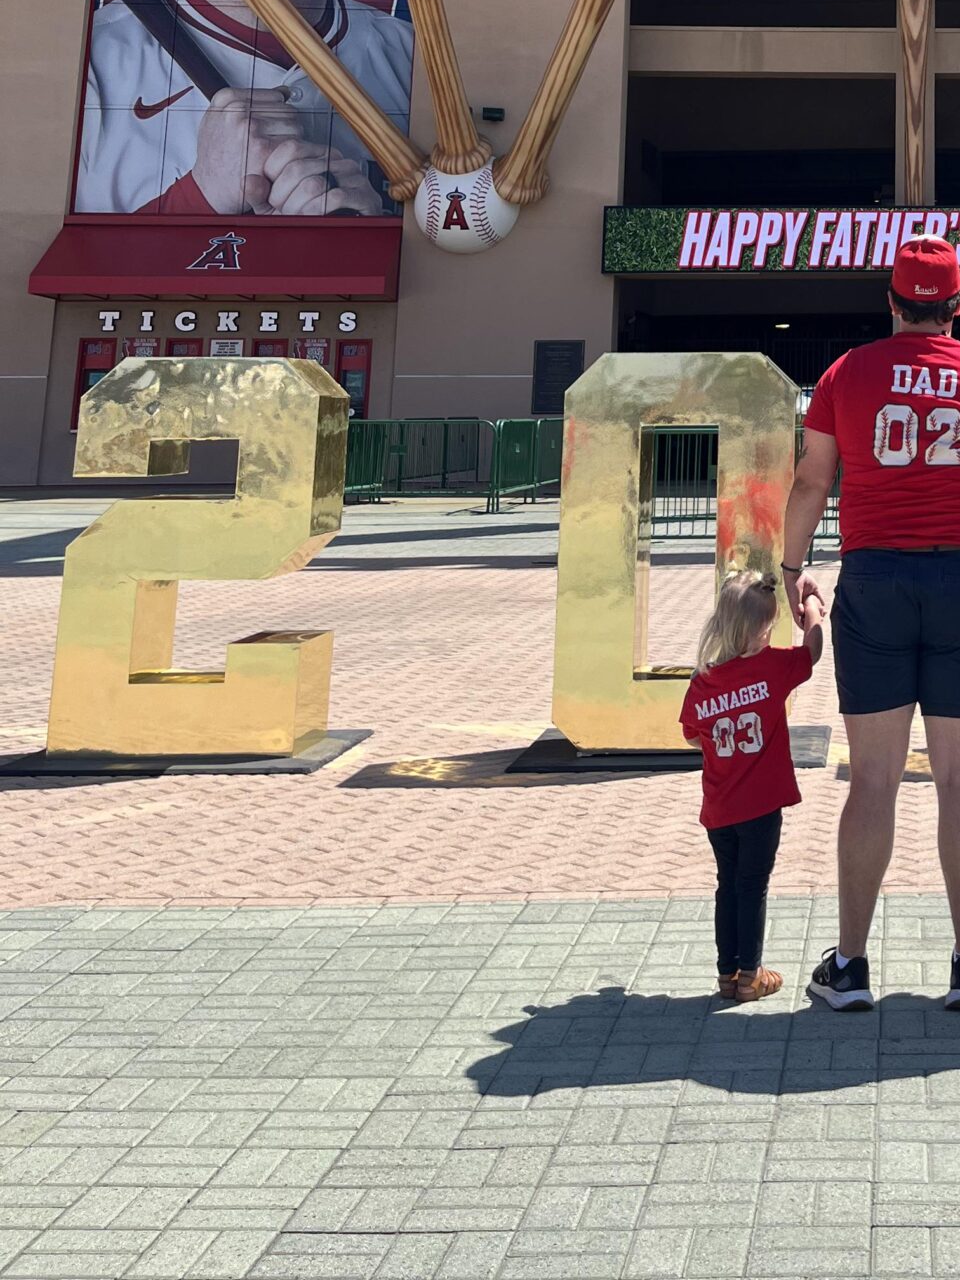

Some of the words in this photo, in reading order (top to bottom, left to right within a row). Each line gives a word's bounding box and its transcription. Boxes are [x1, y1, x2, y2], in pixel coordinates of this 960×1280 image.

[678, 211, 811, 269] HAPPY
[98, 310, 358, 333] TICKETS
[891, 364, 958, 398] DAD
[694, 680, 770, 721] MANAGER
[711, 711, 764, 758] 03
